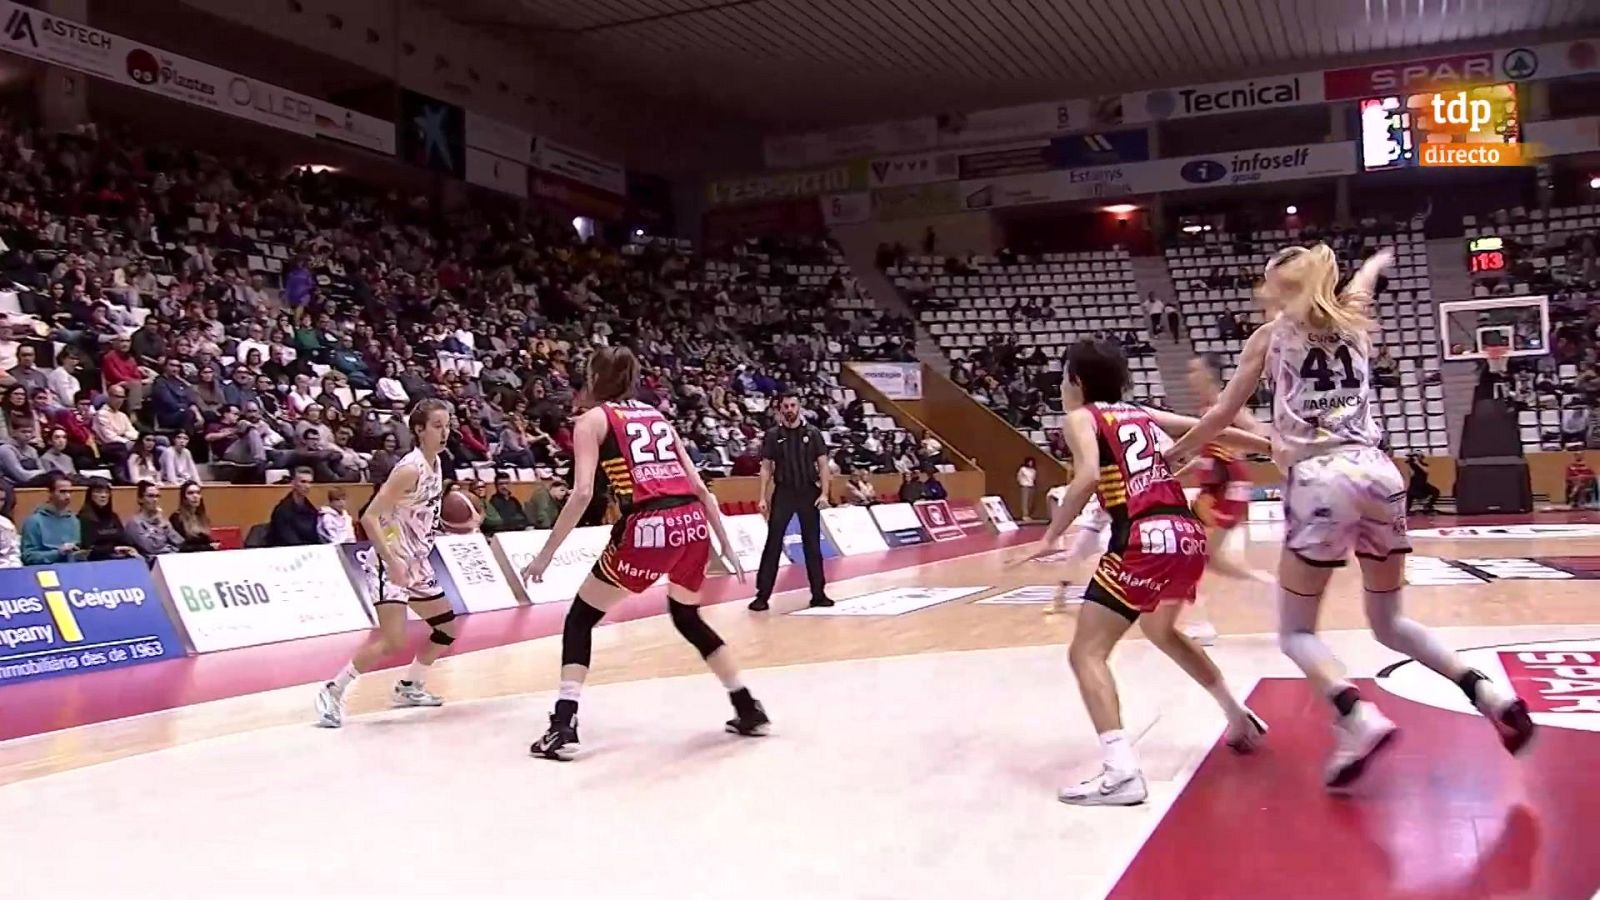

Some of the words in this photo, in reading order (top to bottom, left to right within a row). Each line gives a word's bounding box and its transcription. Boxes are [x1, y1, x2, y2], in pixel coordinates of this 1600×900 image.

[42, 18, 112, 49] ASTECH
[1370, 57, 1494, 91] SPAR
[1179, 77, 1299, 113] Tecnical
[1231, 147, 1309, 173] infoself
[1300, 345, 1361, 391] 41
[625, 421, 677, 463] 22
[617, 559, 662, 581] Marle
[68, 587, 145, 609] Ceigrup
[180, 585, 215, 612] Be
[214, 579, 270, 608] Fisio
[80, 651, 107, 667] des
[108, 647, 128, 662] de
[129, 641, 164, 659] 1963
